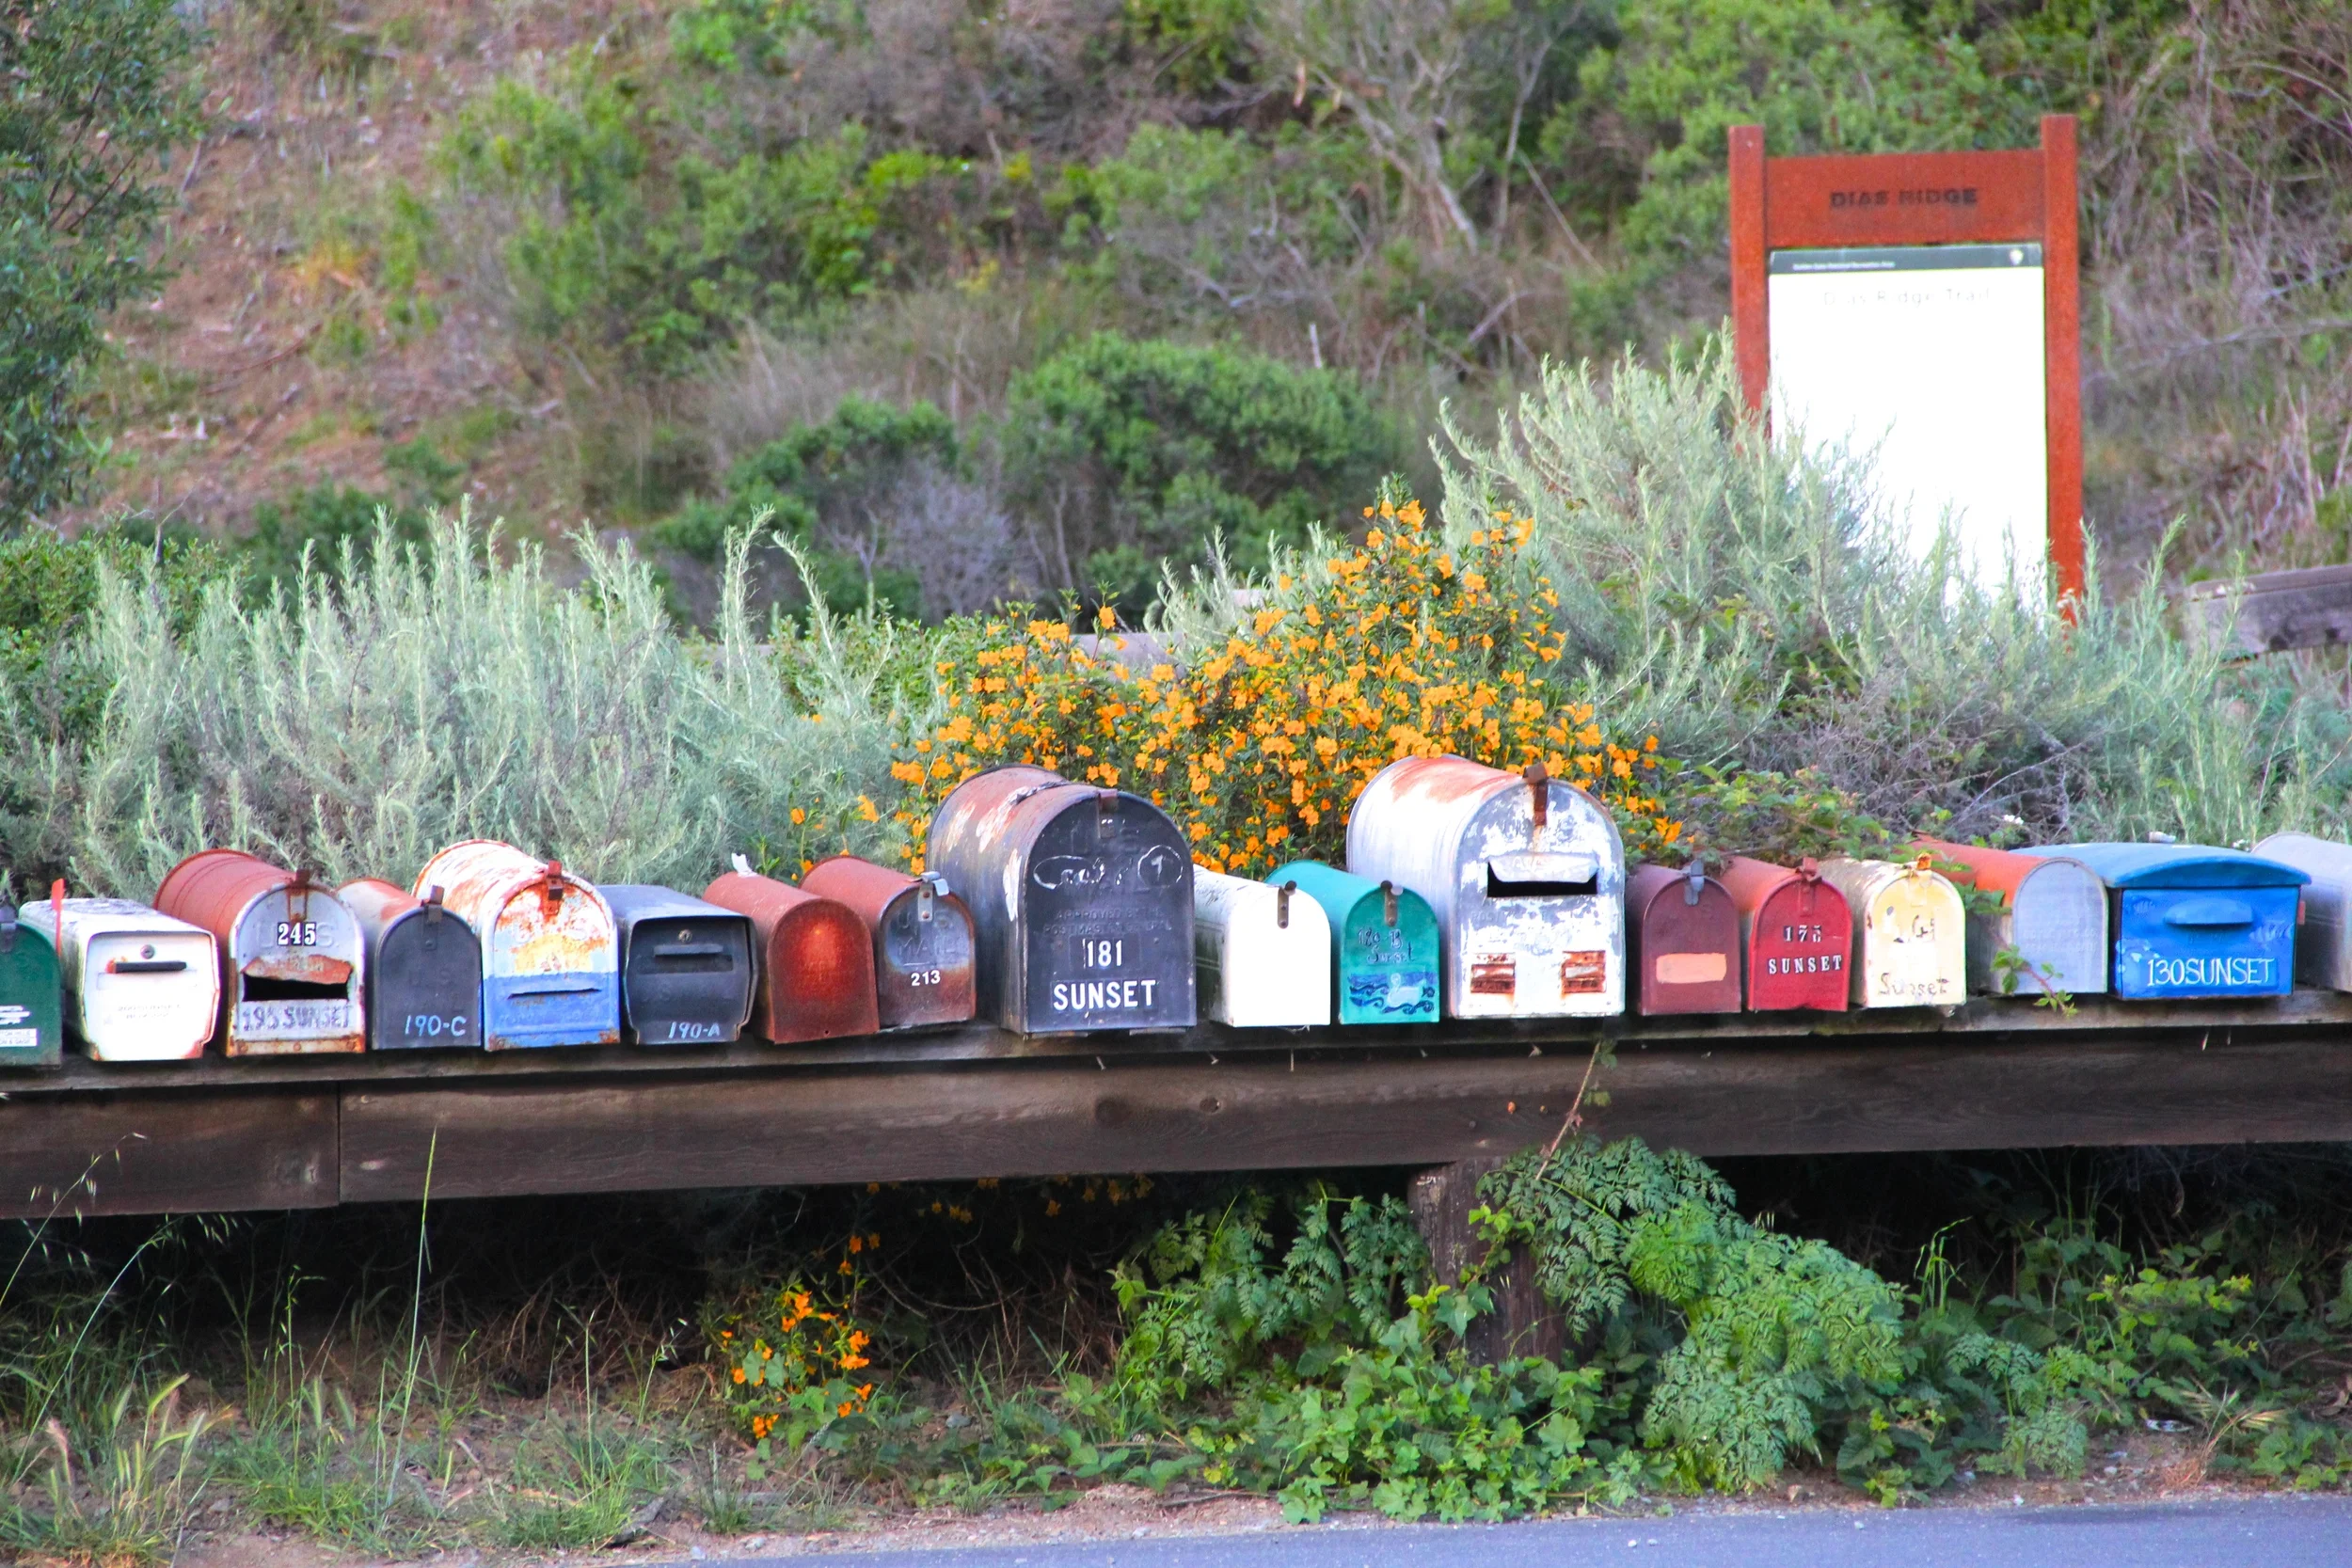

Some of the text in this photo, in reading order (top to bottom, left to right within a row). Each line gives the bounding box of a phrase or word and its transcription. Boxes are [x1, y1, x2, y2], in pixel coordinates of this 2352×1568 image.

[1831, 188, 1978, 208] DIAS RIDGE
[278, 923, 316, 945] 245
[1087, 939, 1122, 968] 181
[1768, 955, 1842, 975] SUNSET
[911, 969, 941, 987] 213
[1053, 979, 1157, 1012] SUNSET
[404, 1014, 468, 1037] 190-C
[668, 1020, 722, 1039] 190-A
